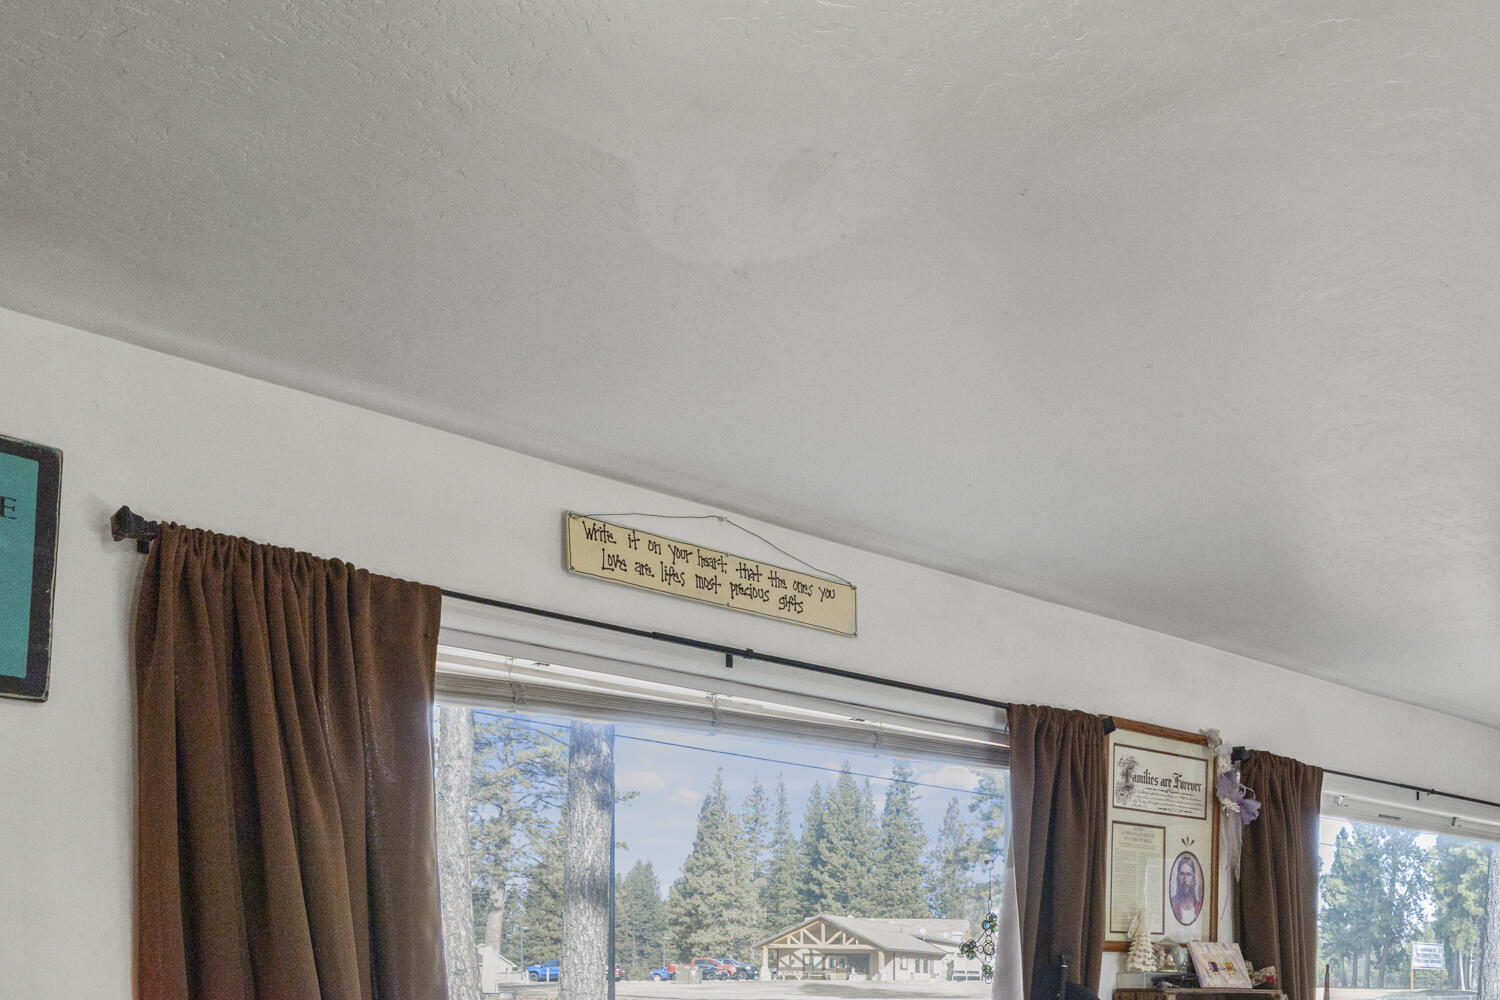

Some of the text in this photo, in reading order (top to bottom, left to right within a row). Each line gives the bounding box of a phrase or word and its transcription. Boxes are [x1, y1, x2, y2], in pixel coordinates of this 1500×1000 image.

[582, 521, 616, 544] Write
[627, 530, 640, 550] it
[648, 540, 661, 555] on
[668, 544, 692, 565] your
[735, 562, 762, 582] that
[768, 570, 787, 589] the
[793, 580, 813, 596] ones
[818, 587, 835, 602] you
[602, 548, 627, 572] Love
[634, 562, 655, 577] are
[695, 574, 721, 594] most
[730, 582, 770, 602] precious
[778, 594, 803, 613] gifts
[1120, 767, 1202, 792] Families are Forever
